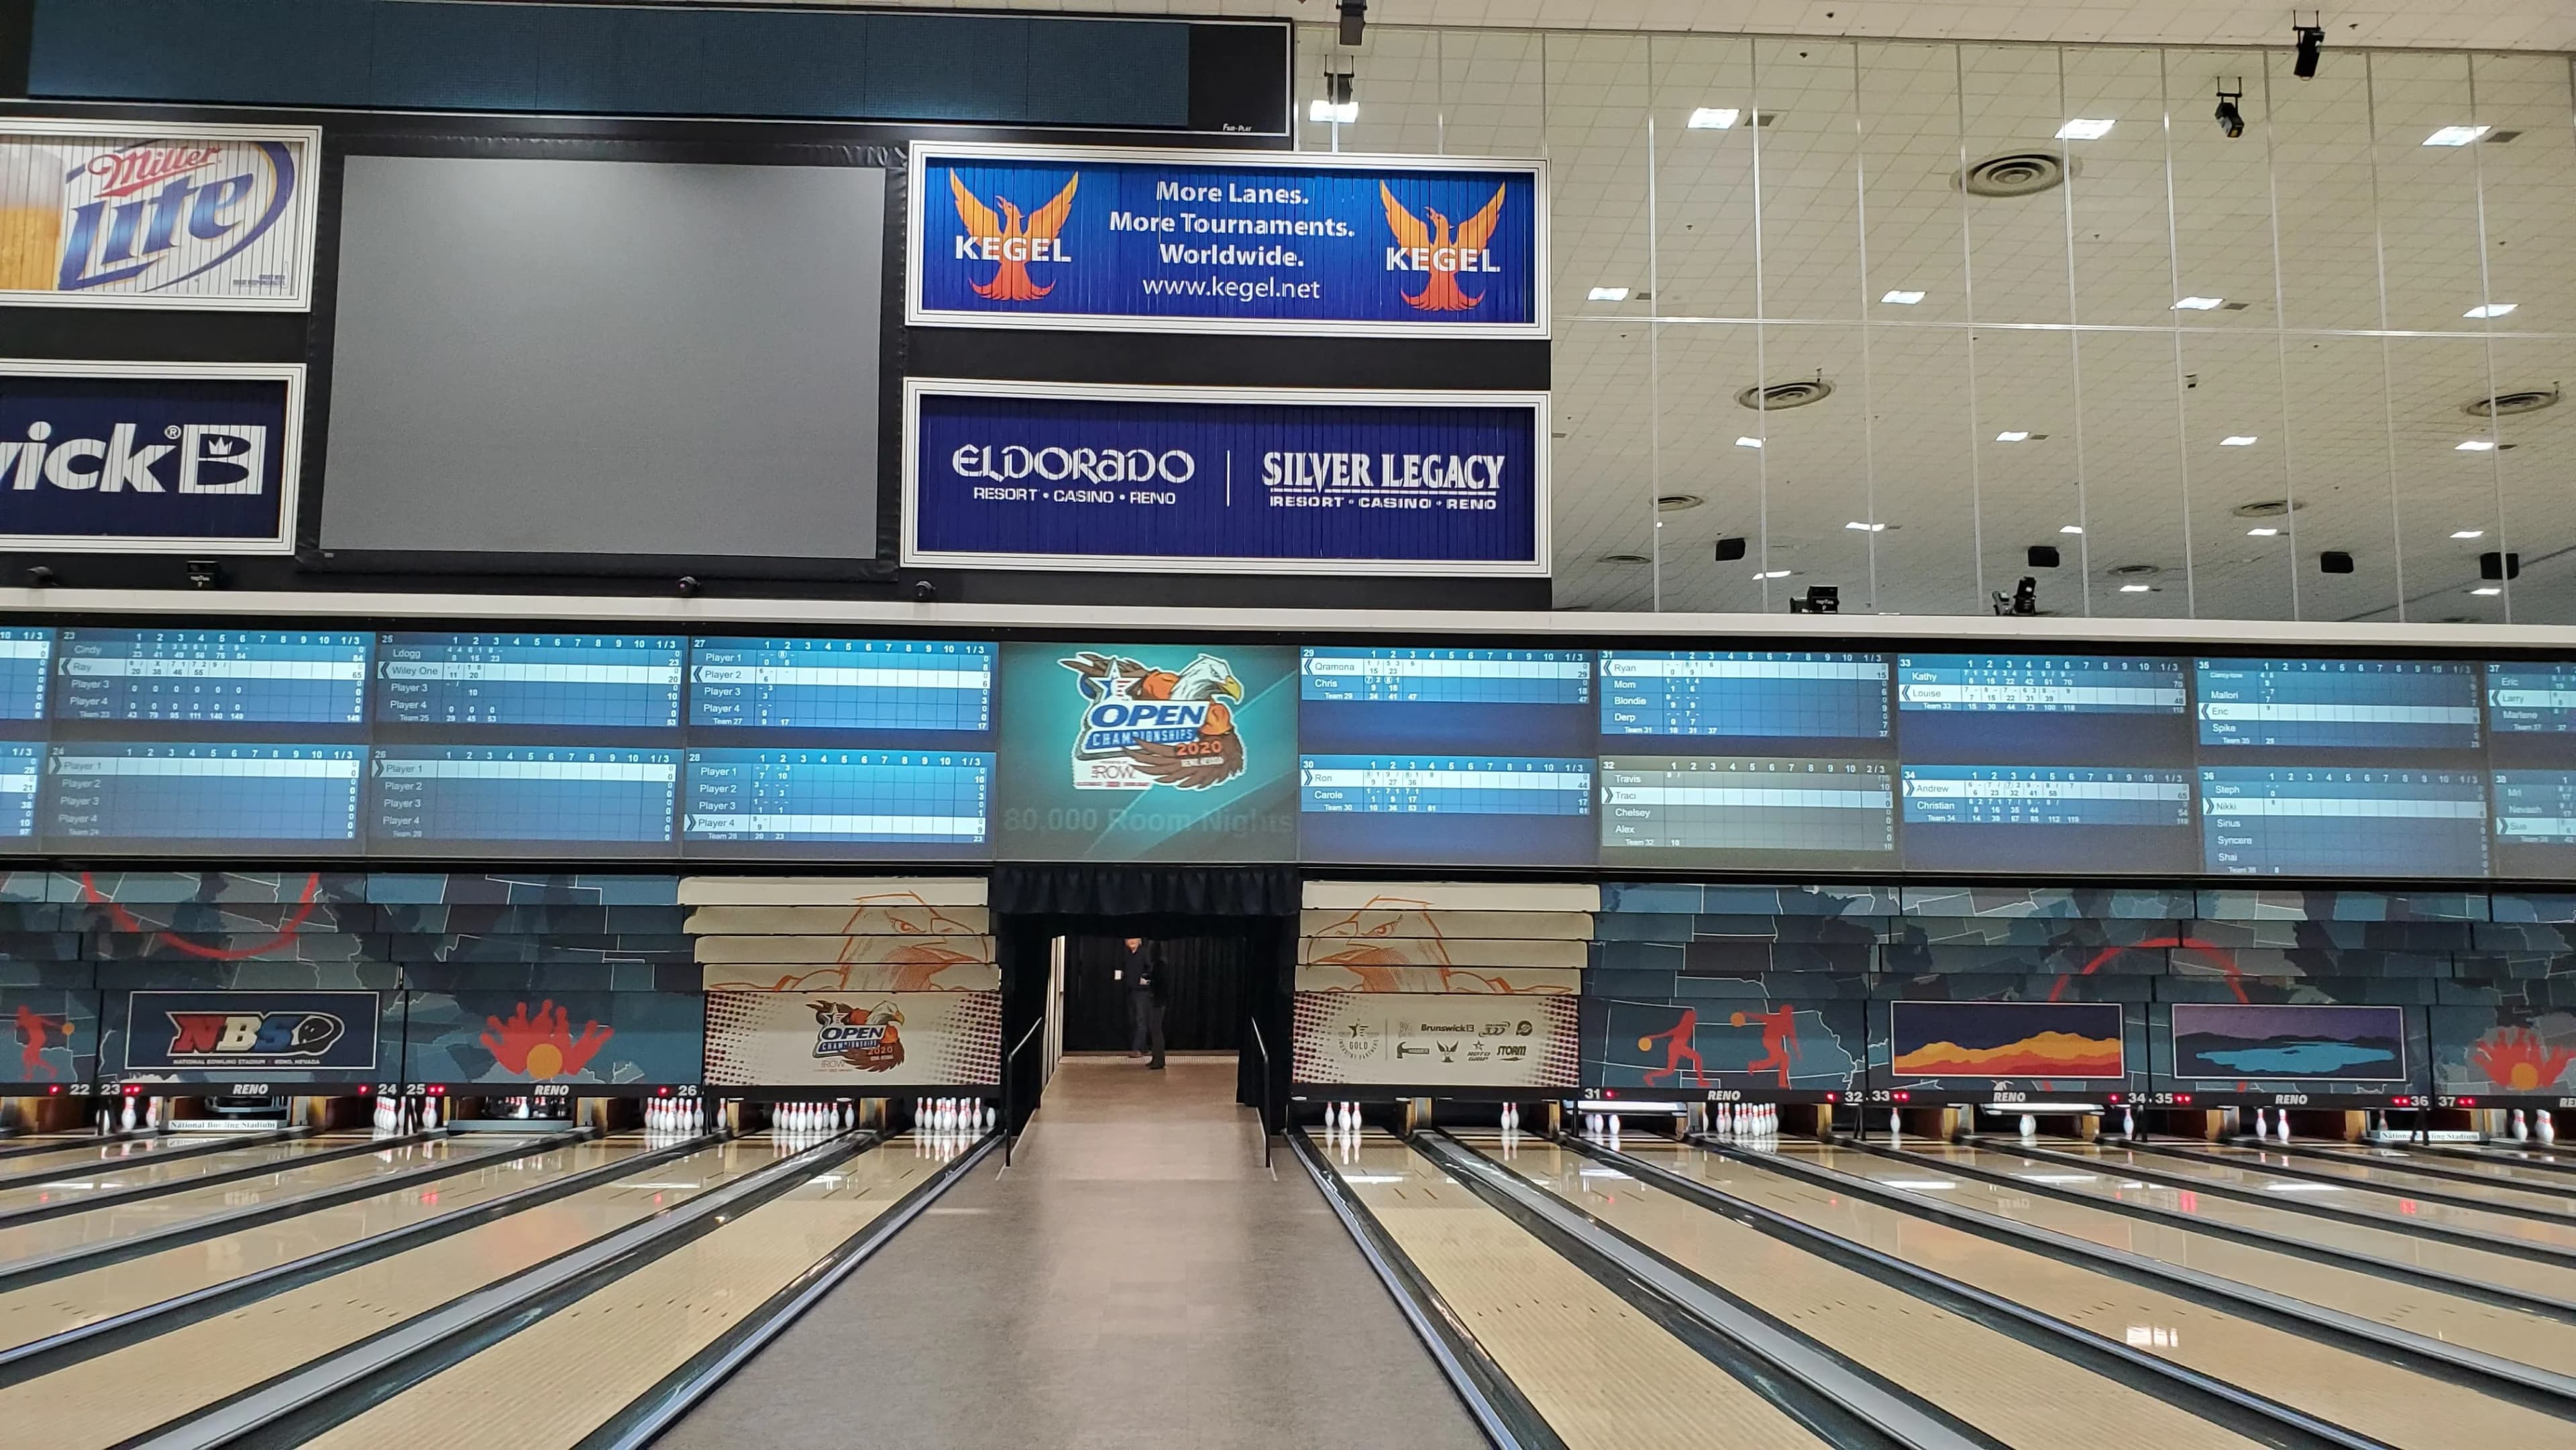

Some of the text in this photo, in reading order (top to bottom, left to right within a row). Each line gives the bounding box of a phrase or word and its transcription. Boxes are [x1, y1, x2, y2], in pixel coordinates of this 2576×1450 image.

[87, 146, 221, 190] Miller
[1157, 180, 1309, 205] More Lanes.
[1110, 211, 1355, 239] More Tournaments.
[58, 173, 254, 291] Lite
[955, 235, 1071, 263] KEGEL
[1160, 244, 1303, 267] Worldwide.
[1386, 247, 1500, 273] KEGEL
[1142, 277, 1320, 302] www.kegel.net
[1262, 452, 1505, 491] SILVER LEGACY
[973, 487, 1176, 505] RESORT CASINO RENO
[1270, 495, 1497, 510] RESORT CASINO RENO
[64, 631, 75, 639] 23
[74, 645, 101, 656] Cindy
[393, 650, 420, 659] Ldogg
[706, 654, 741, 662] Player 1
[72, 663, 91, 672] Ray
[392, 666, 416, 676] Wiley
[1614, 664, 1636, 672] Ryan
[705, 670, 734, 680] Player
[1912, 672, 1937, 682] Kathy
[72, 680, 109, 689] Player 3
[391, 683, 427, 693] Player 3
[1315, 679, 1337, 688] Chris
[1614, 680, 1635, 688] Mom
[704, 687, 733, 696] Player
[1913, 689, 1941, 698] Louise
[2211, 691, 2238, 699] Mallori
[1615, 696, 1646, 705] Blondie
[2503, 694, 2524, 703] Larry
[703, 704, 740, 713] Player 4
[1091, 704, 1205, 727] OPEN
[1615, 713, 1635, 723] Derp
[2212, 724, 2236, 732] Spike
[1093, 729, 1193, 746] CHAMPIONSHIPS
[52, 747, 64, 756] 24
[1176, 741, 1222, 756] 2020
[1315, 774, 1332, 782] Ron
[1615, 775, 1641, 783] Travis
[62, 778, 101, 789] Player 2
[385, 782, 414, 791] Player
[1917, 784, 1949, 793] Andrew
[2215, 785, 2239, 794] Steph
[1314, 791, 1342, 799] Carole
[1615, 792, 1635, 800] Traci
[384, 799, 421, 808] Player 3
[1917, 801, 1955, 810] Christian
[2217, 802, 2236, 811] Nikki
[1615, 808, 1650, 818] Chelsey
[698, 819, 726, 828] Player
[1109, 809, 1191, 832] Room
[1202, 809, 1293, 837] Nights
[1615, 825, 1635, 833] Alex
[2218, 853, 2237, 862] Shai
[173, 1016, 302, 1052] NBS
[822, 1027, 883, 1040] OPEN
[1350, 1041, 1368, 1049] GOLD
[868, 1047, 893, 1055] 2020
[1497, 1046, 1526, 1055] STORM
[70, 1084, 89, 1095] 22
[101, 1084, 120, 1095] 23
[233, 1084, 268, 1094] RENO
[378, 1084, 397, 1095] 24
[407, 1084, 425, 1095] 25
[535, 1085, 569, 1096] RENO
[678, 1085, 696, 1096] 26
[1585, 1088, 1601, 1099] 31
[1707, 1090, 1741, 1101] RENO
[1845, 1091, 1862, 1102] 32
[1872, 1090, 1890, 1101] 33
[1993, 1092, 2026, 1102] RENO
[2128, 1093, 2145, 1103] 34
[2155, 1093, 2173, 1104] 35
[2275, 1094, 2308, 1105] RENO
[2410, 1096, 2429, 1106] 36
[2438, 1096, 2455, 1106] 37
